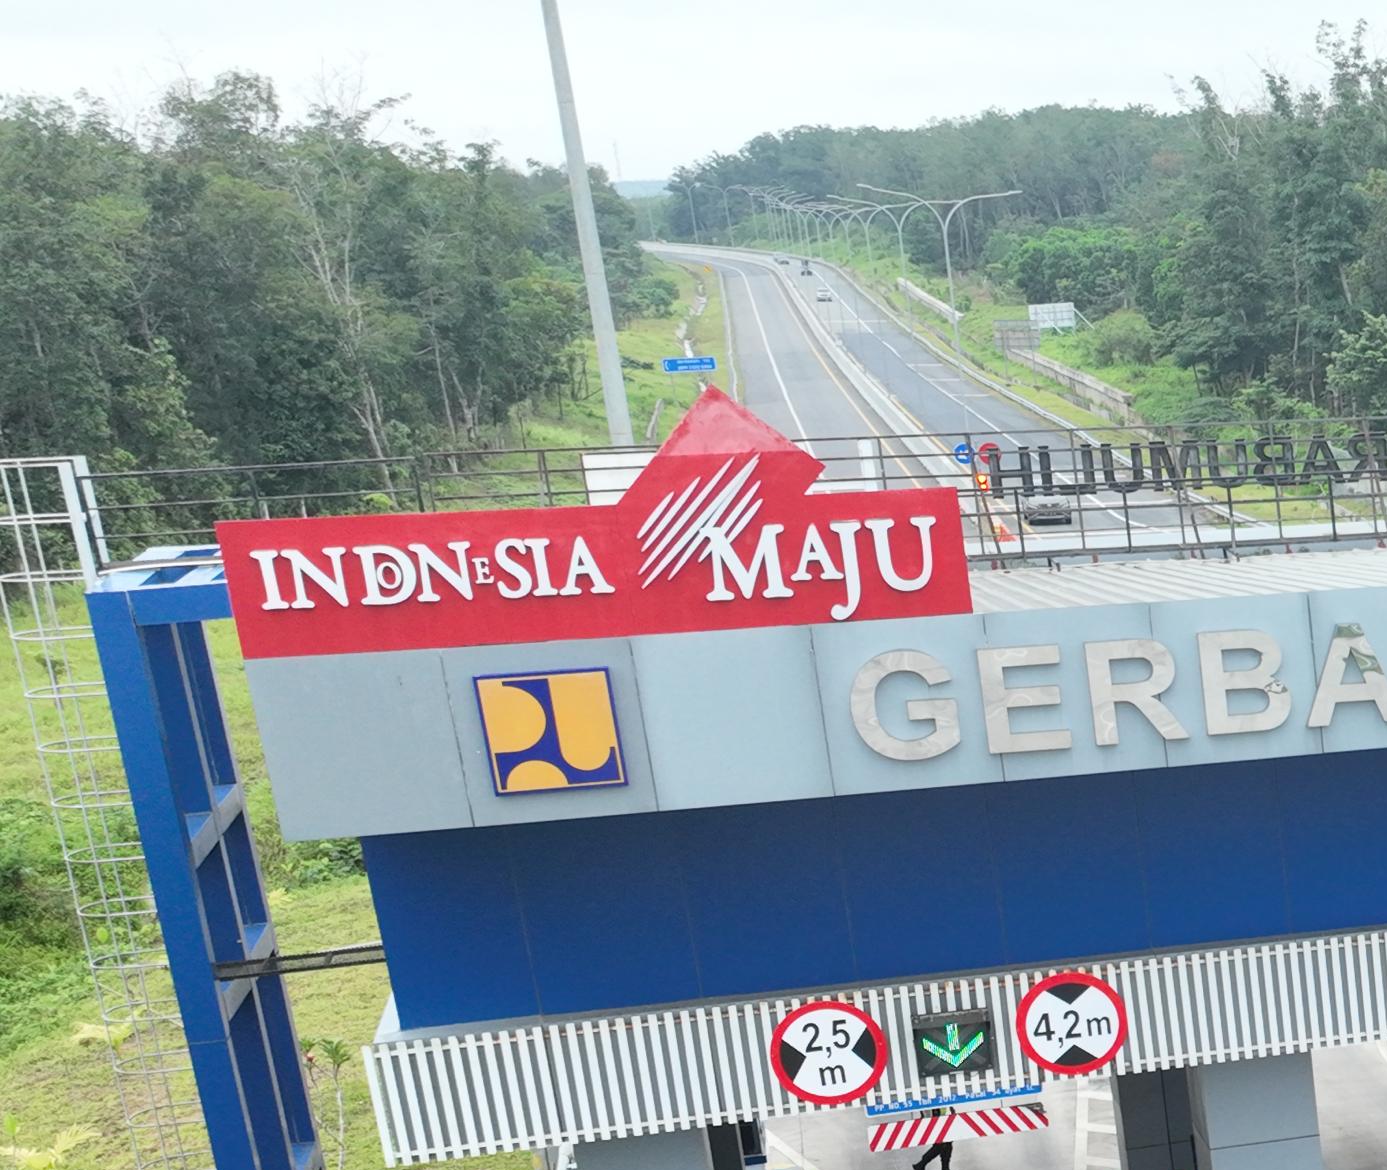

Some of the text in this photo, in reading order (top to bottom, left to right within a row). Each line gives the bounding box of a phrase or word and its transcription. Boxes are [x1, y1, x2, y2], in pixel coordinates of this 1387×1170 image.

[249, 516, 937, 621] INDONESIA MAJU
[802, 1019, 851, 1059] 2,5
[818, 1061, 847, 1087] m
